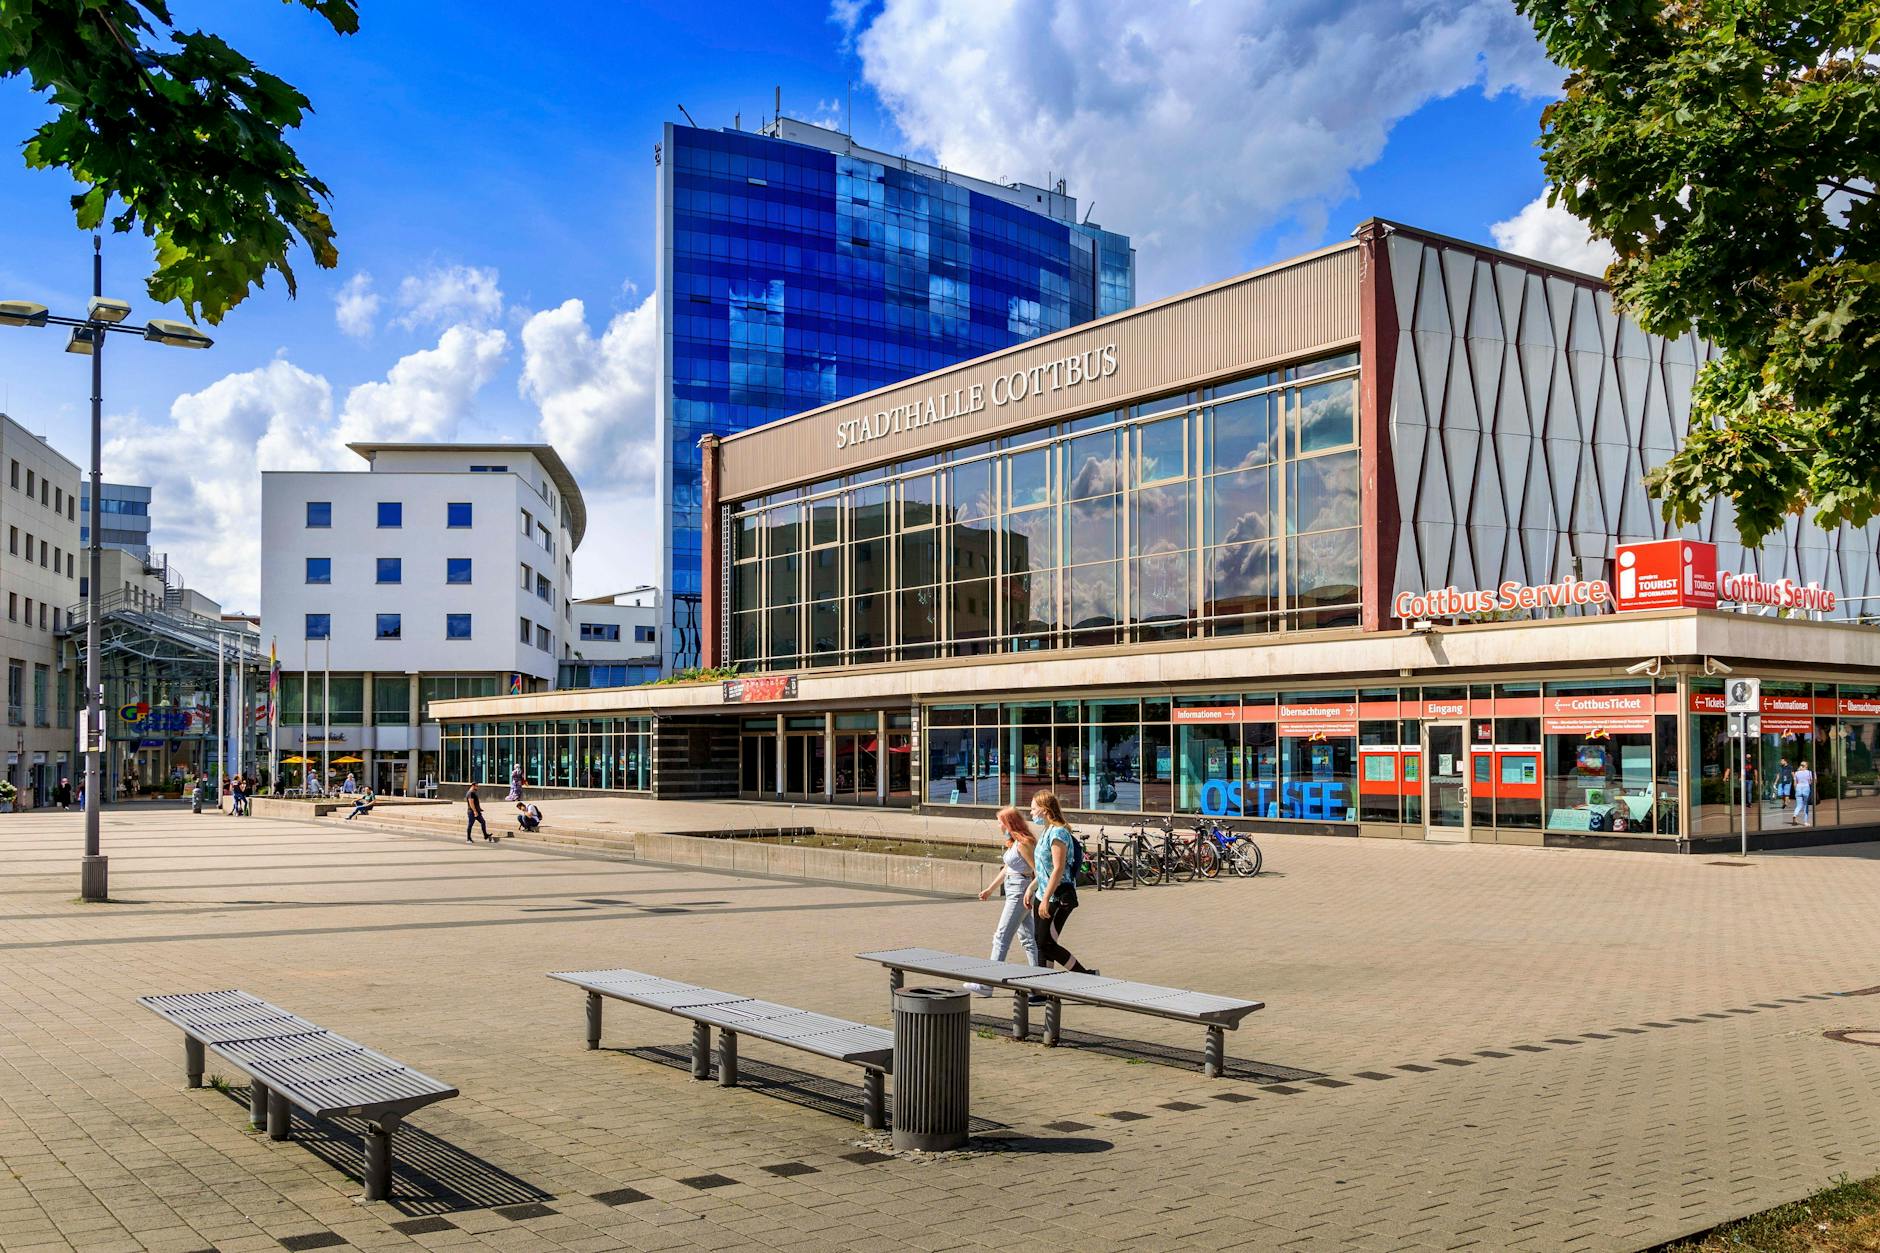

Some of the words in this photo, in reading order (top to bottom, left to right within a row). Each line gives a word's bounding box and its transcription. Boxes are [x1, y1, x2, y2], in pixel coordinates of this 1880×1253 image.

[836, 383, 986, 450] STADTHALLE
[991, 343, 1119, 406] COTTBUS
[1638, 579, 1678, 591] TOURIST
[1694, 580, 1715, 592] TOURIST
[1720, 570, 1781, 606] Cottbus
[1783, 578, 1837, 611] Service
[1395, 586, 1498, 618] Cottbus
[1499, 575, 1607, 610] Service
[1638, 590, 1678, 598] INFORMATION
[1572, 698, 1641, 710] CottbusTicket
[1705, 697, 1725, 708] Tickets
[1773, 700, 1808, 710] Informationen
[1177, 710, 1222, 719] Informationen
[1281, 706, 1340, 718] Übernachtungen
[1428, 703, 1463, 715] Eingang
[1201, 779, 1344, 821] OSTSEE
